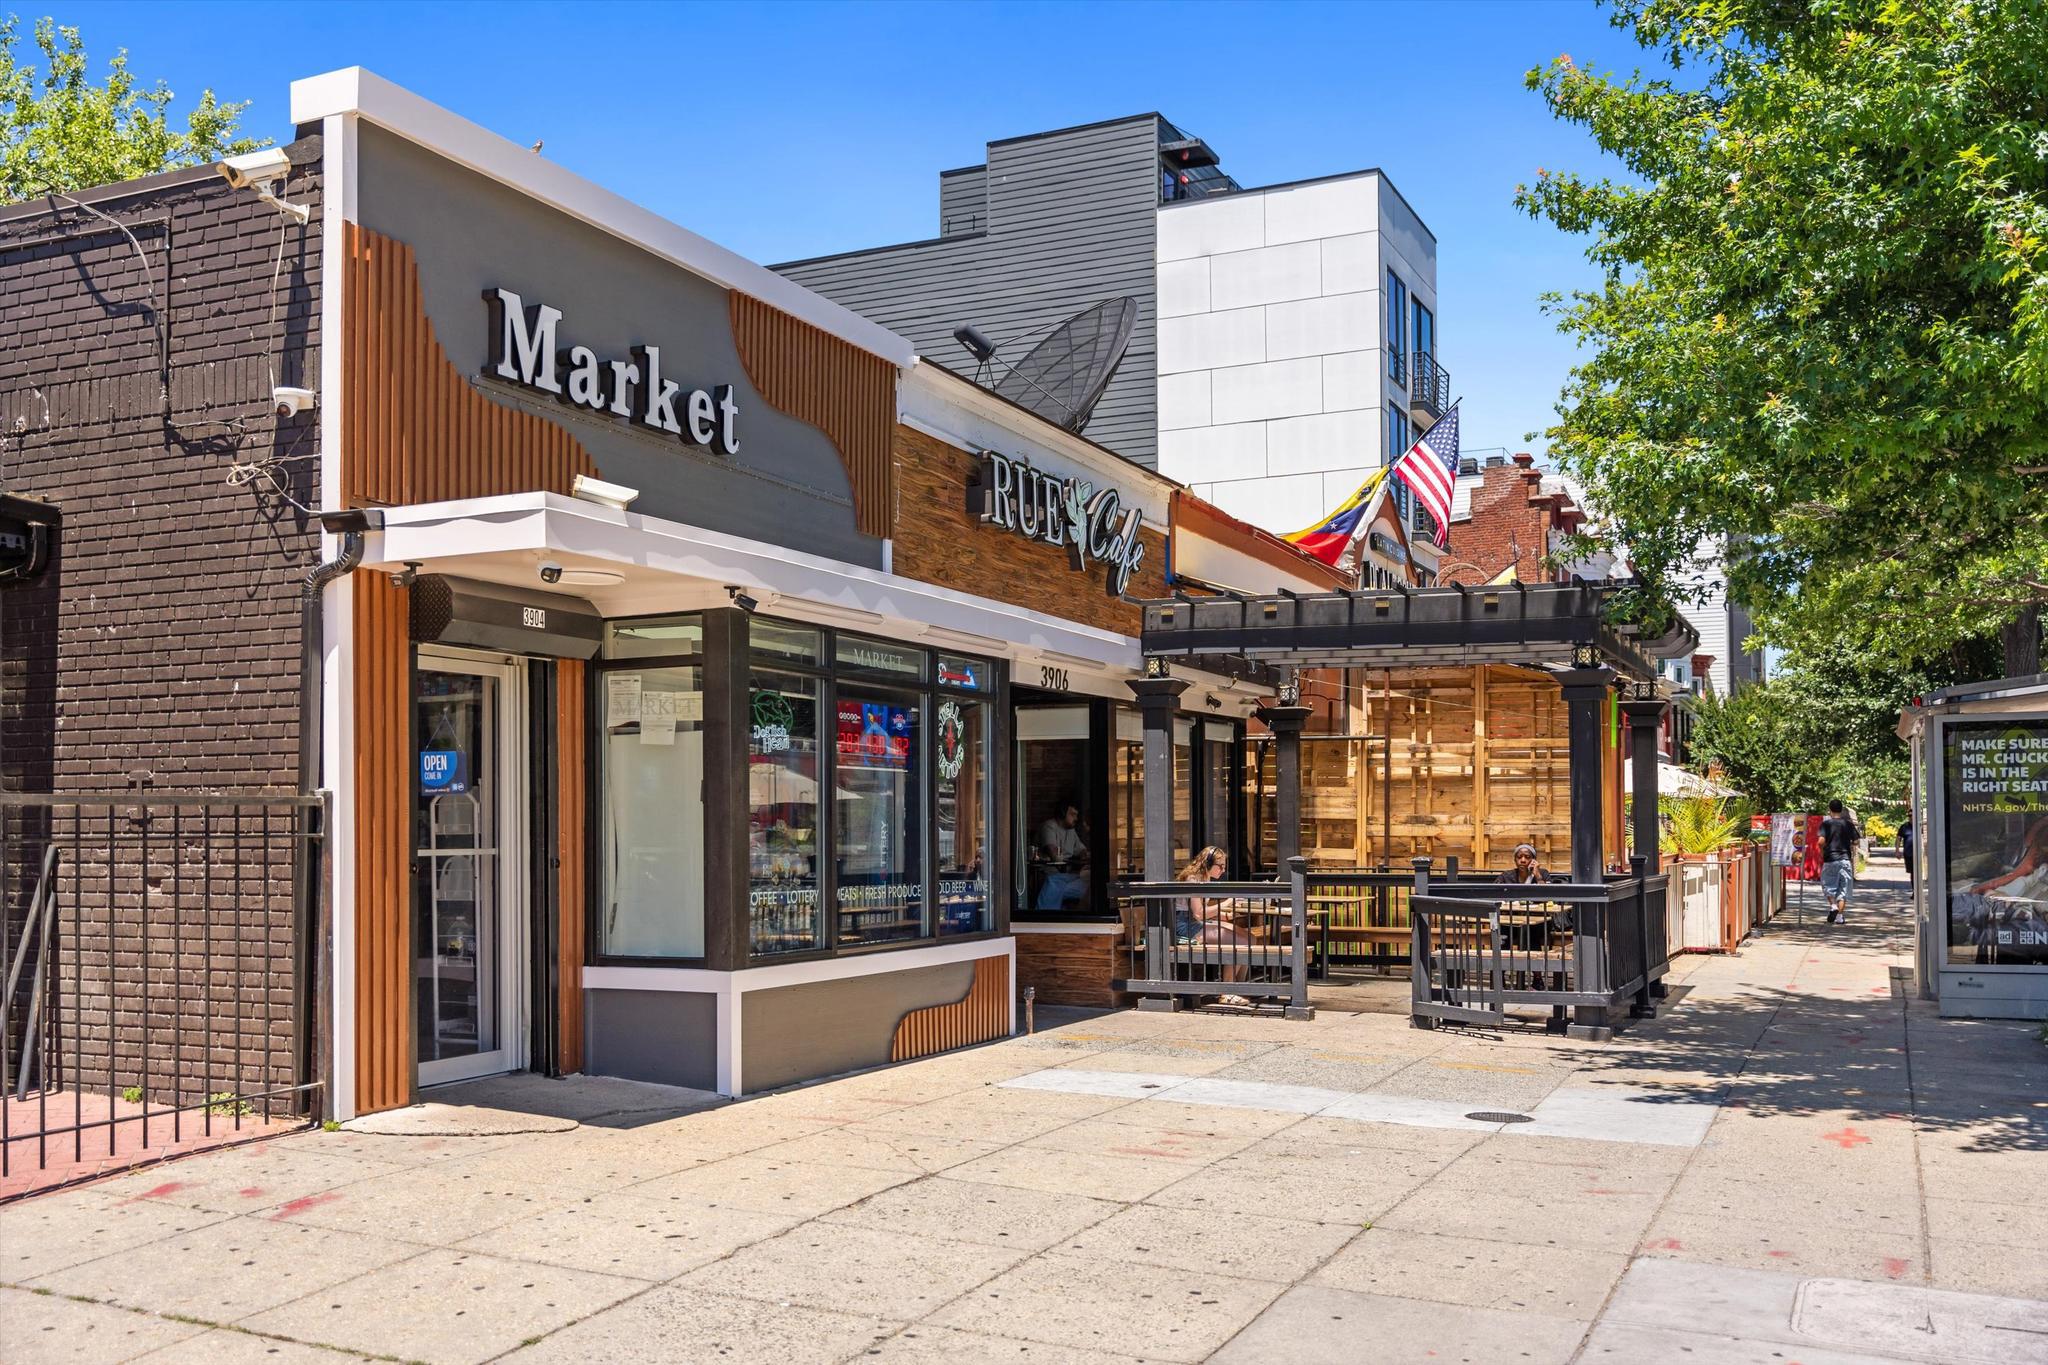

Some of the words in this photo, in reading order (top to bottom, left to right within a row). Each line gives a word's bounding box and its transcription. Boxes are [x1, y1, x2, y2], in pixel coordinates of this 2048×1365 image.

[495, 287, 741, 455] Market
[990, 451, 1065, 549] RUE
[1087, 488, 1146, 596] Cafe
[525, 608, 544, 627] 3904
[854, 648, 904, 671] MARKET
[1041, 665, 1069, 691] 3906
[1962, 739, 2006, 750] MAKE
[2009, 738, 2048, 749] SURE
[424, 755, 447, 771] OPEN
[1962, 754, 1990, 765] MR.
[1963, 768, 1977, 778] IS
[1980, 768, 1996, 778] IN
[2000, 767, 2029, 778] THE
[1963, 781, 2009, 792] RIGHT
[2012, 780, 2048, 791] SEAT
[865, 886, 887, 900] FRESH
[888, 884, 922, 898] PRODUCE
[952, 881, 967, 893] BEER
[973, 880, 988, 892] WINE
[750, 892, 778, 905] OFFEE
[786, 889, 819, 904] LOTTERY
